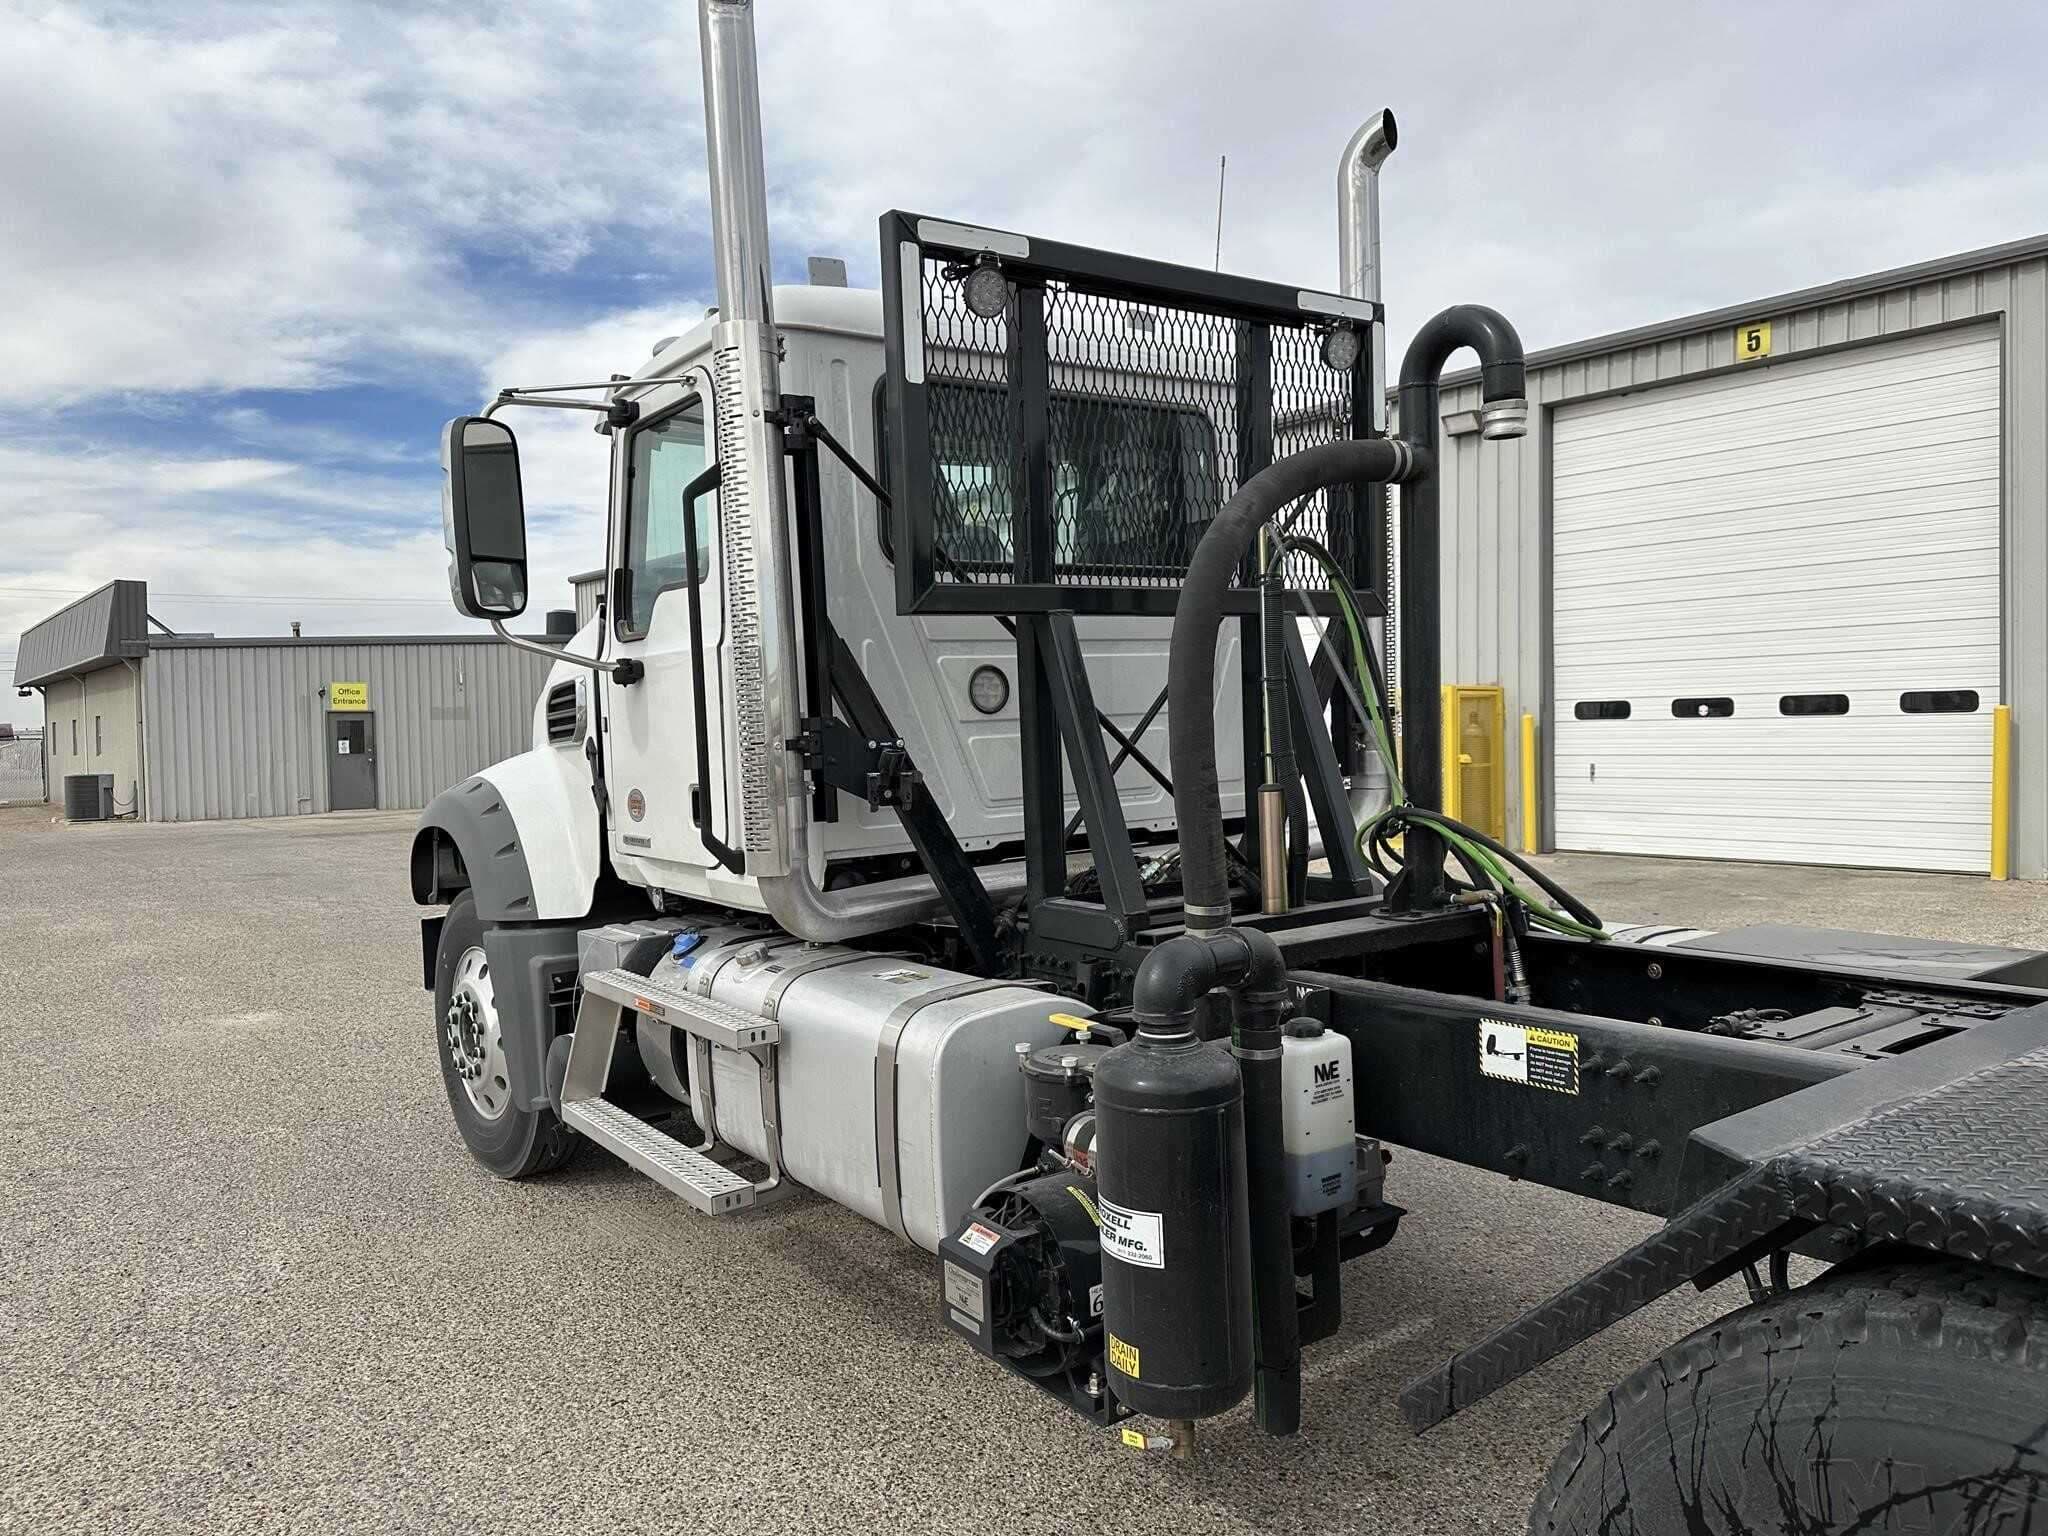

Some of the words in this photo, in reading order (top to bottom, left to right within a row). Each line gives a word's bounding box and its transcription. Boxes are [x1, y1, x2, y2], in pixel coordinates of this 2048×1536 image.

[1747, 329, 1761, 352] 5
[1536, 1035, 1571, 1047] CAUTION
[1118, 1236, 1147, 1251] MFG.
[1111, 1336, 1137, 1361] DRAIN
[1111, 1350, 1136, 1375] DAILY
